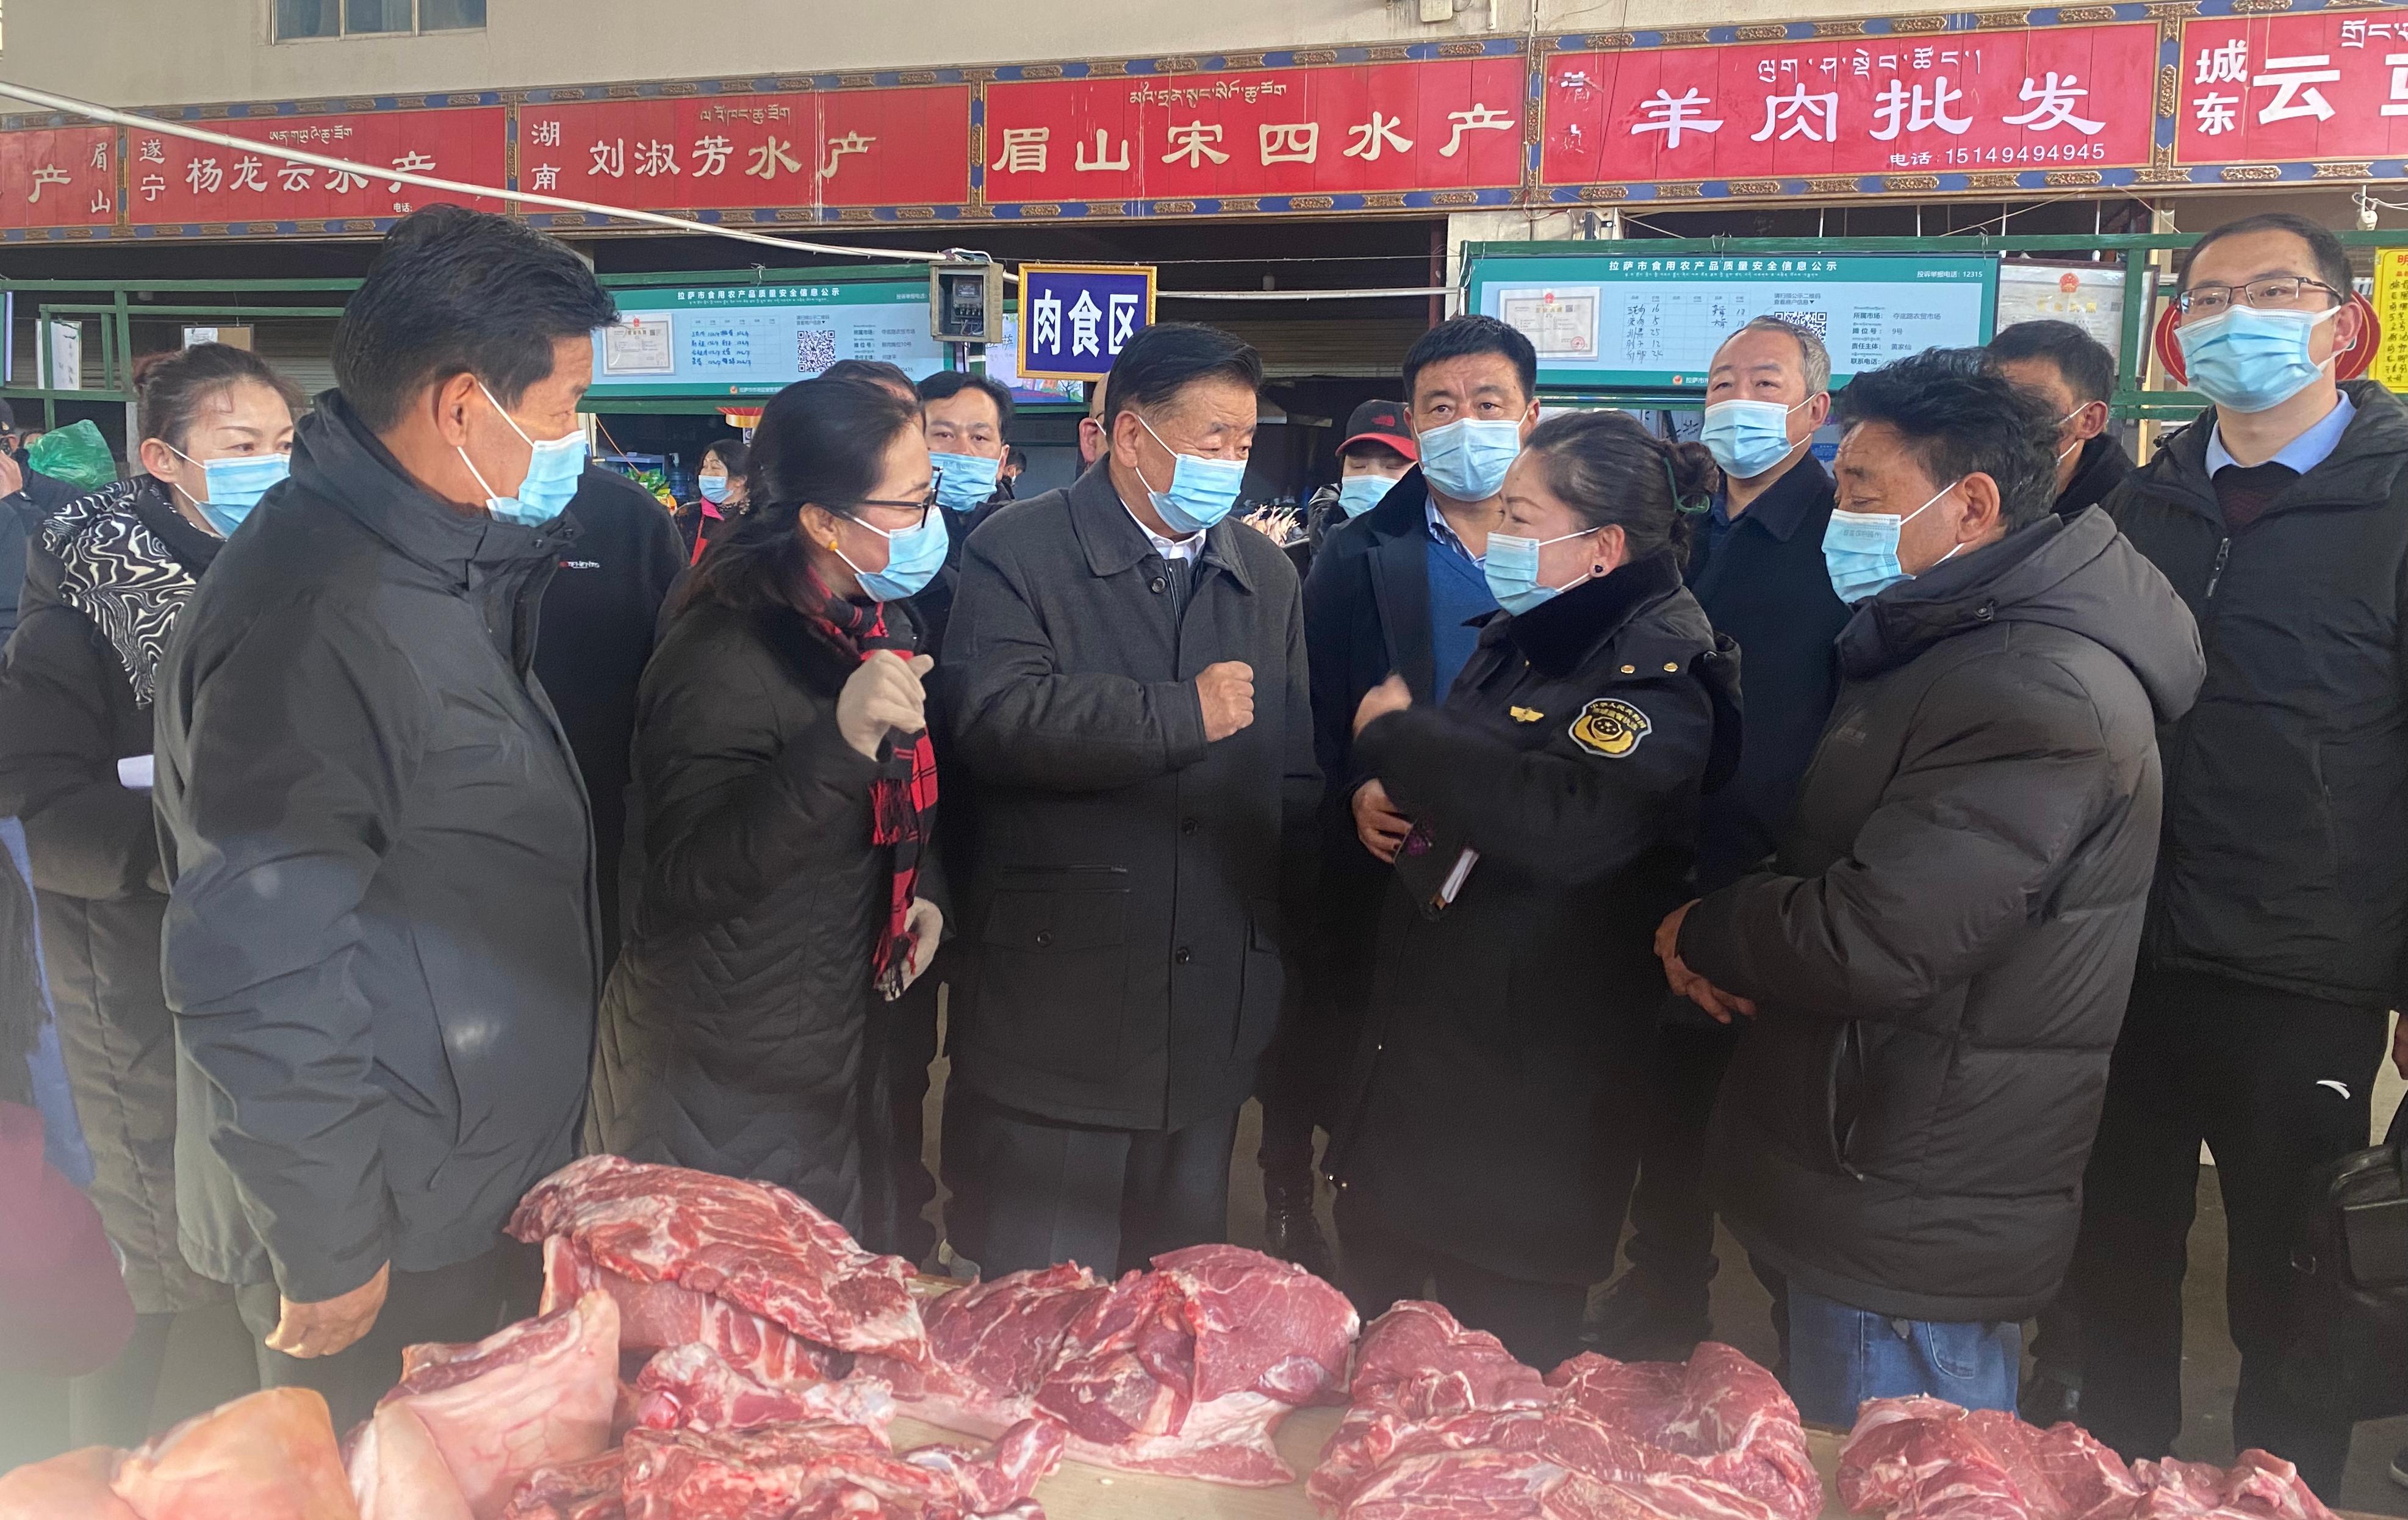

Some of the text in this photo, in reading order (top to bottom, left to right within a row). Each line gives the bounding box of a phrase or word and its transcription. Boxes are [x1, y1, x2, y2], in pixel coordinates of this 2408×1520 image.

[1631, 71, 2106, 149] 羊肉批发
[2193, 38, 2248, 135] 城东
[531, 121, 561, 191] 湖南
[588, 131, 876, 179] 刘淑芳水产
[992, 103, 1515, 173] 眉山宋四水产
[1946, 143, 2105, 164] 15149494945
[27, 164, 72, 203] 产
[90, 142, 112, 214] 眉山
[140, 139, 166, 202] 遂宁
[185, 150, 437, 194] 杨龙云水产
[677, 287, 840, 300] 拉萨市食用农产品质量安全信息公示
[1609, 260, 1838, 272] 拉萨市食用农产品质量安全信息公示
[1033, 289, 1138, 358] 肉食区
